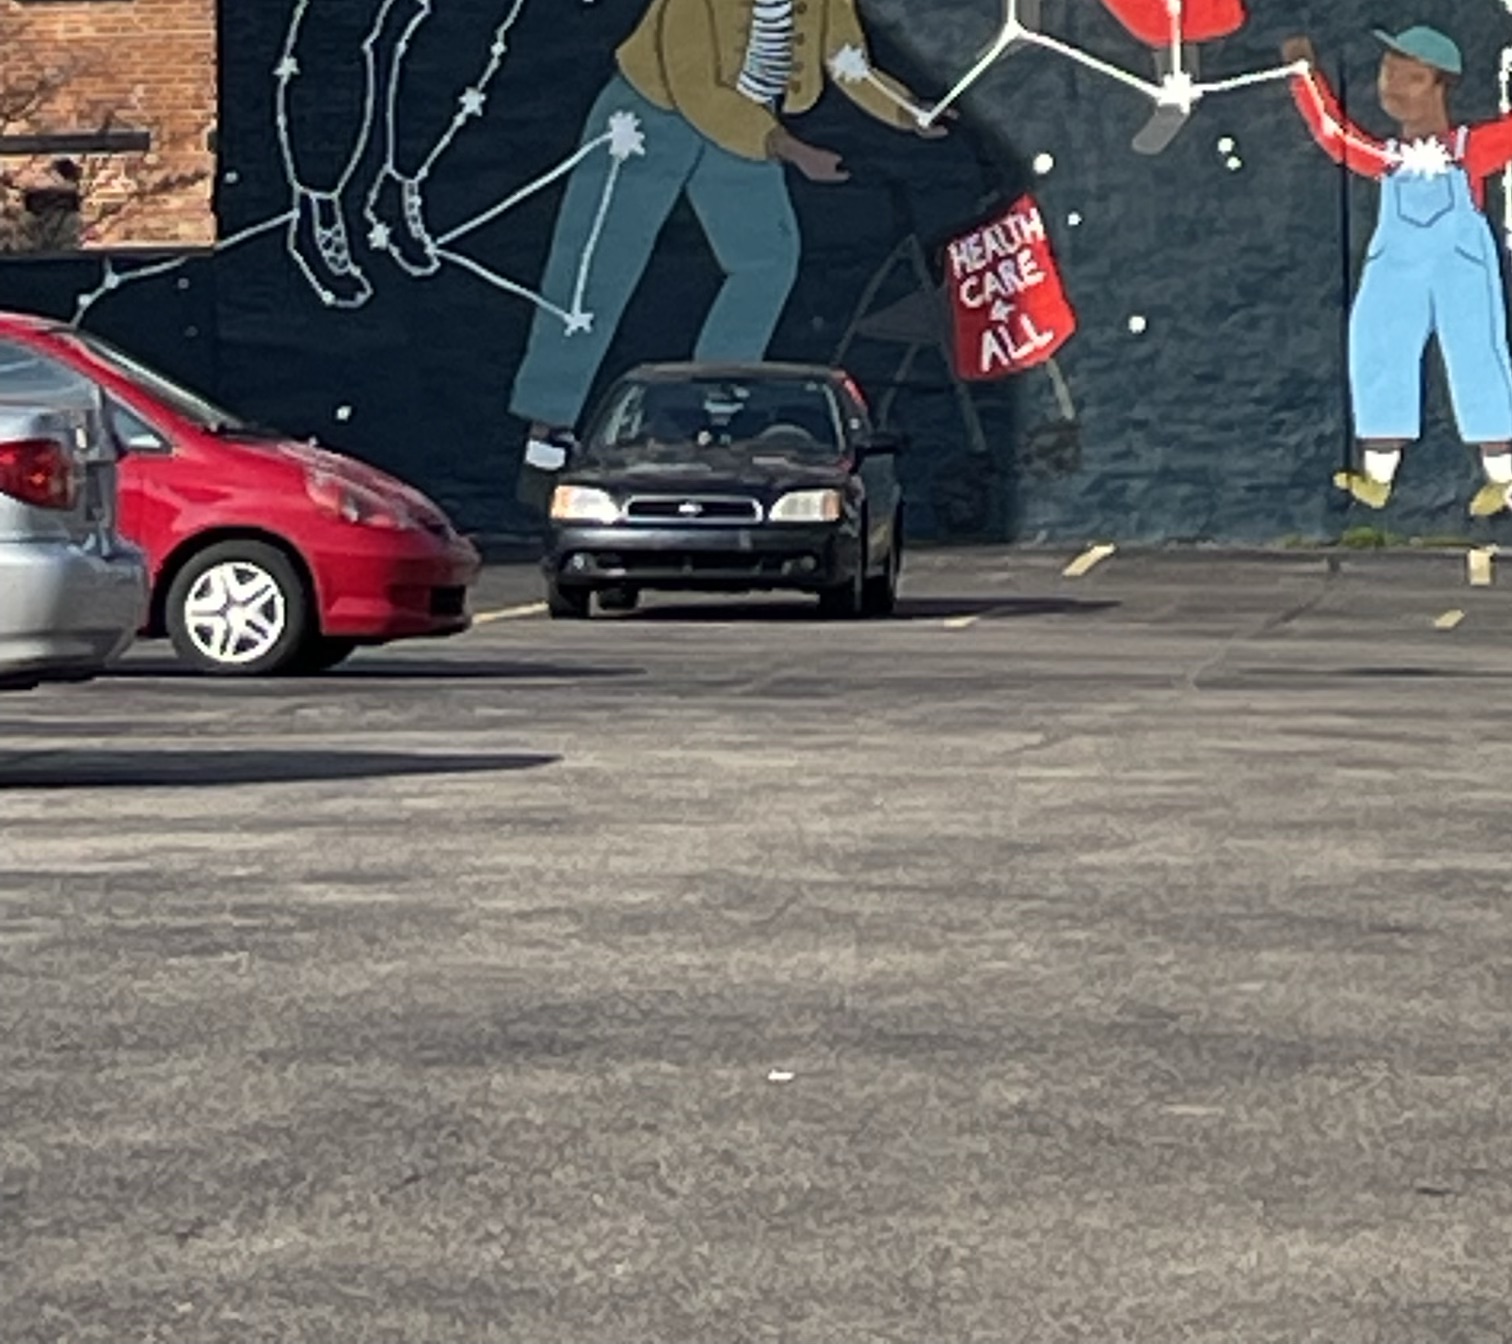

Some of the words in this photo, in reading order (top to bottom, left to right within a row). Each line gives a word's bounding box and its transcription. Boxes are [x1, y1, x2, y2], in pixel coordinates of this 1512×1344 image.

[947, 207, 1045, 279] HEALTH
[960, 249, 1046, 308] CARE
[981, 314, 1054, 372] ALL
